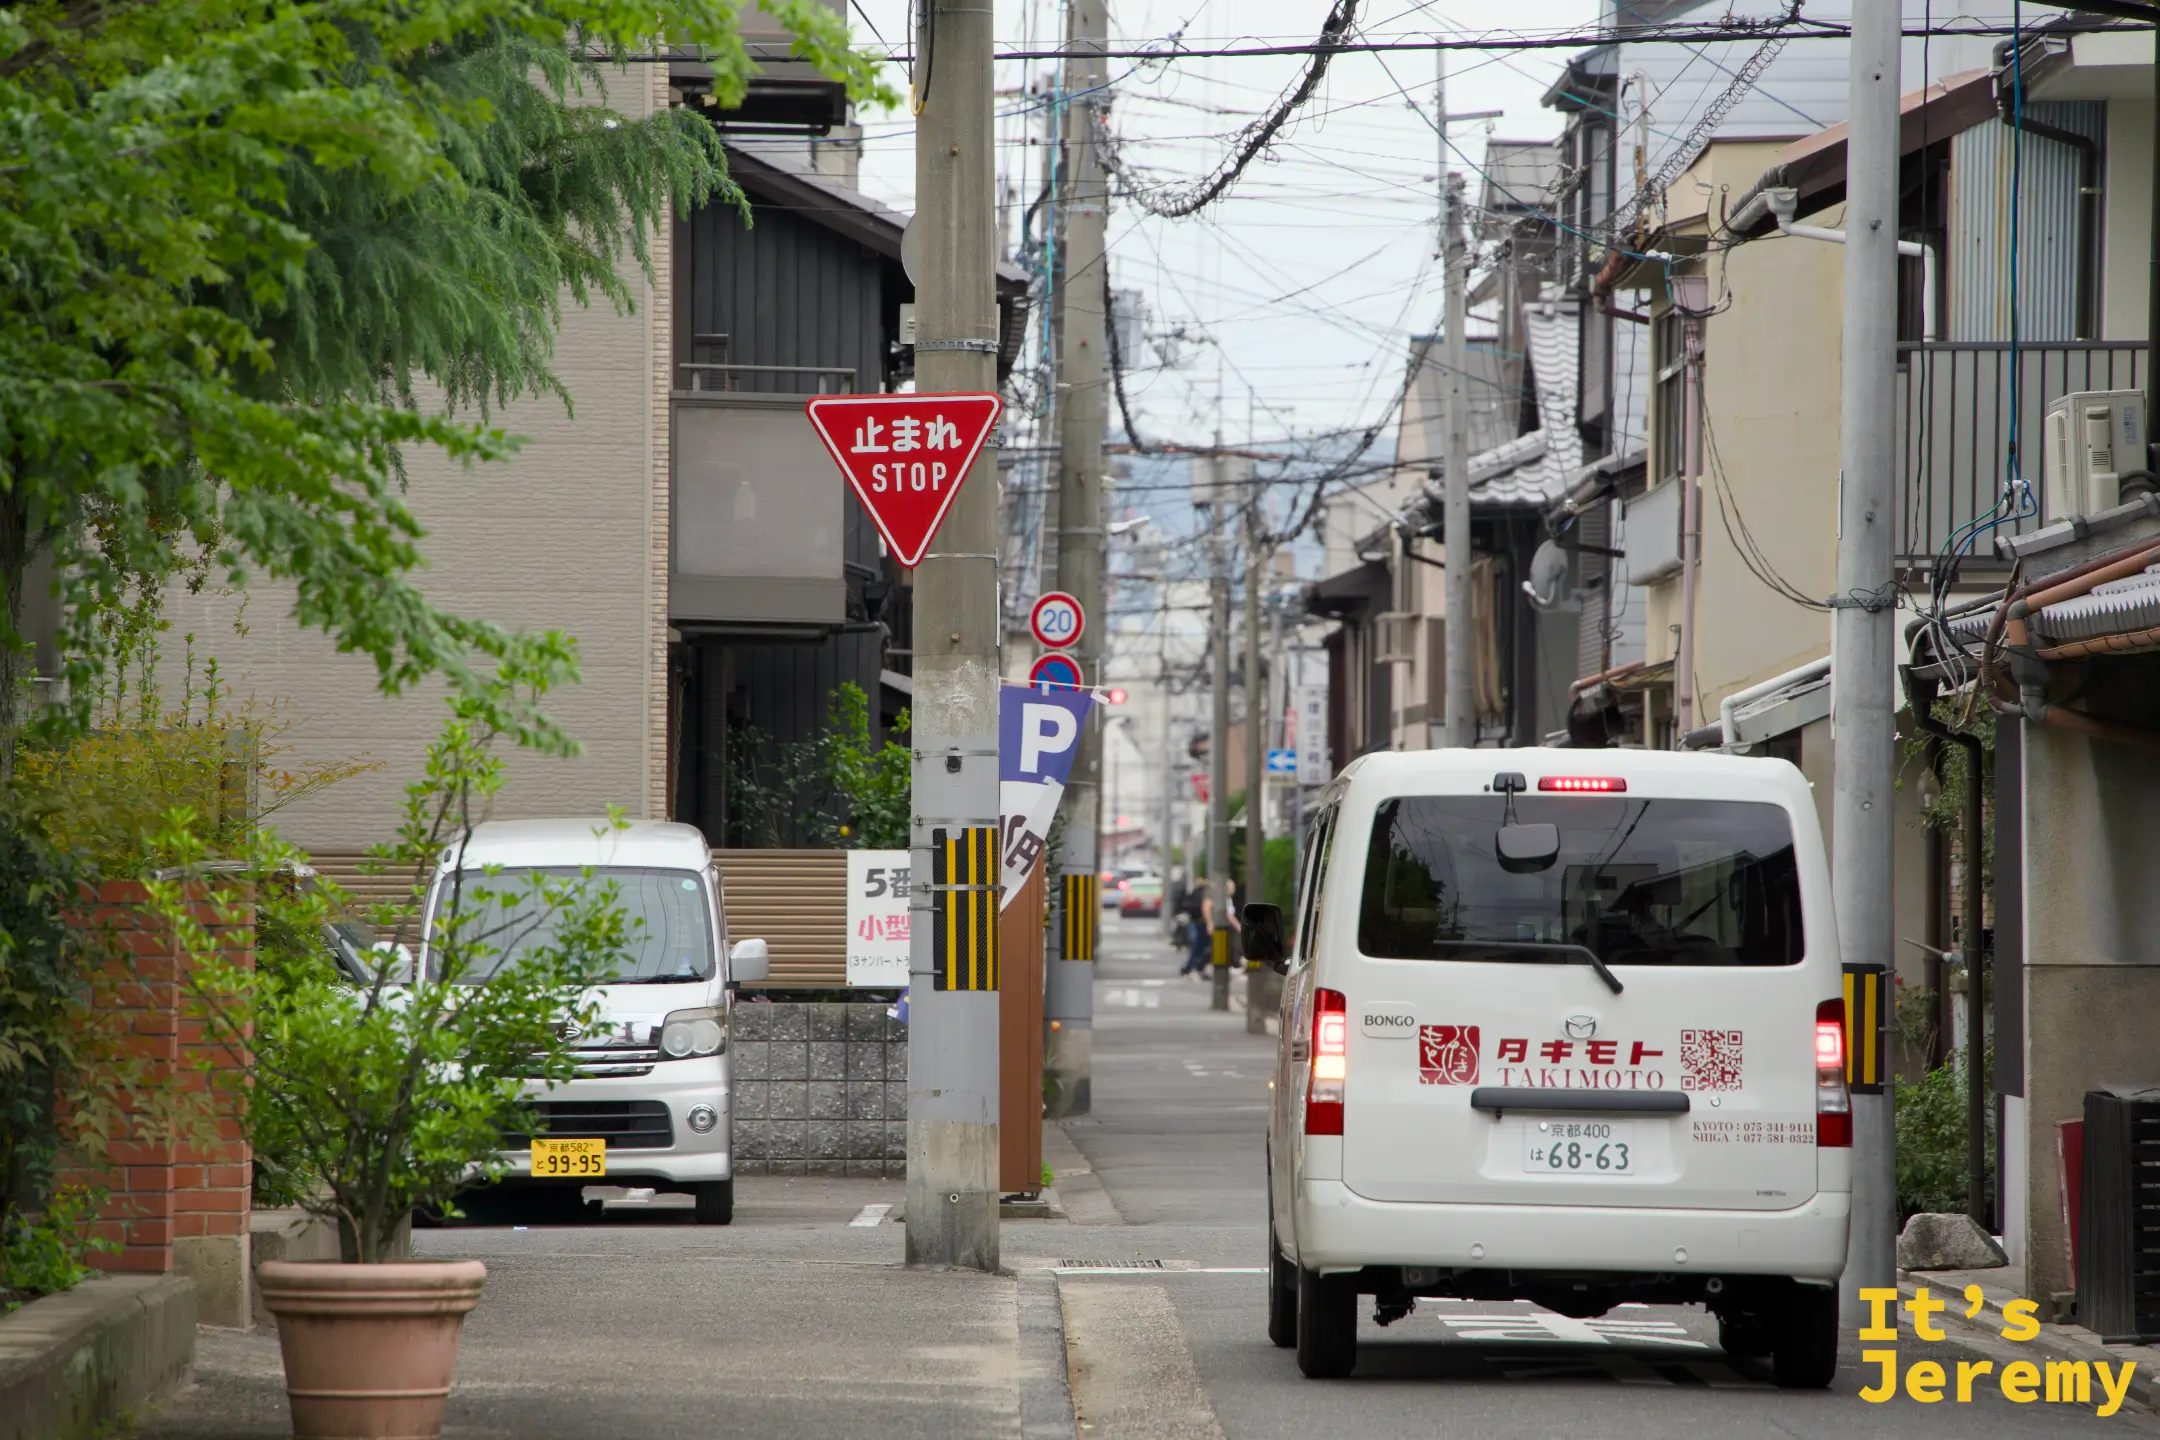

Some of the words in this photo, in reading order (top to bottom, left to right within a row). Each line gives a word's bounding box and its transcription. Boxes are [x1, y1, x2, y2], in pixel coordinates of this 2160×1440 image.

[850, 414, 962, 454] 止まれ
[872, 462, 947, 493] STOP
[1043, 609, 1072, 633] 20
[1019, 702, 1078, 774] P
[857, 914, 911, 941] 小型
[1364, 1014, 1415, 1027] BONGO
[1497, 1038, 1664, 1066] タキモト
[1496, 1067, 1665, 1090] TAKIMOTO
